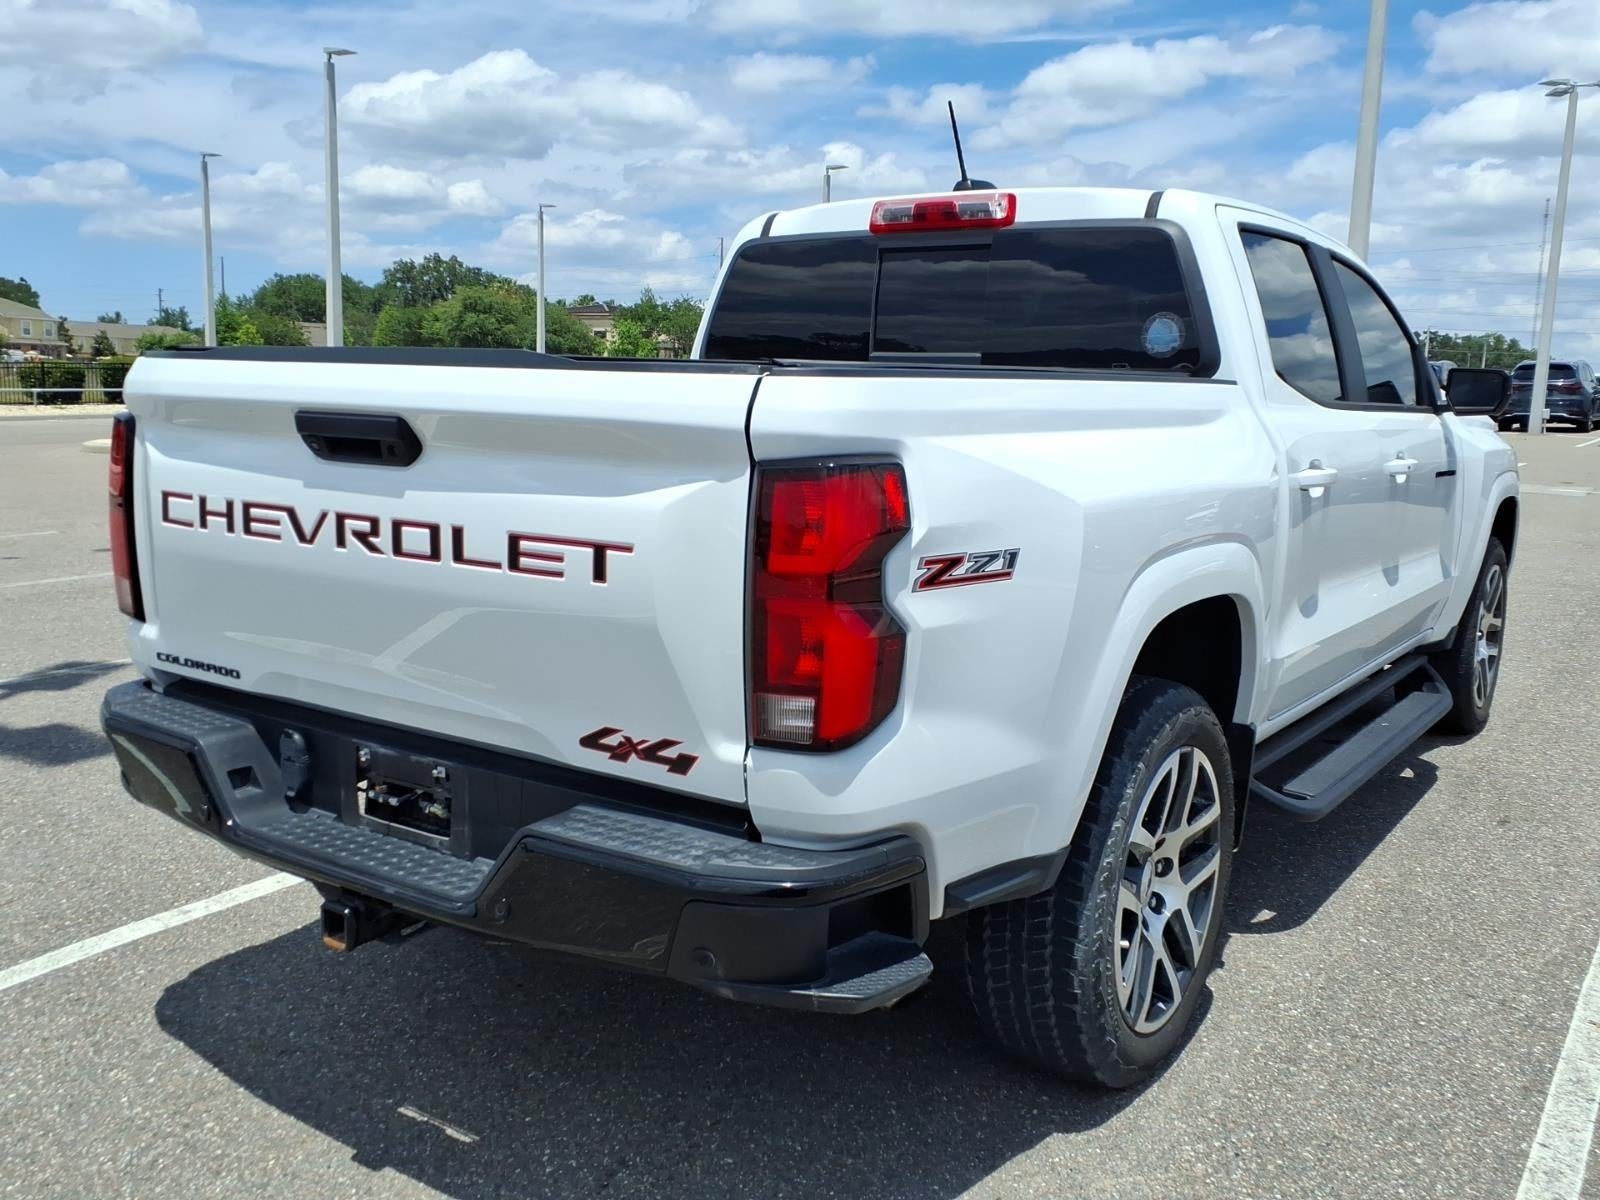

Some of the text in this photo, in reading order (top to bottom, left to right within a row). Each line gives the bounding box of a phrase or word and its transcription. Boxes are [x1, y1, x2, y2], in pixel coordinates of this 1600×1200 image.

[161, 489, 634, 585] CHEVROLET
[912, 548, 1020, 593] Z71
[156, 651, 241, 680] COLORADO
